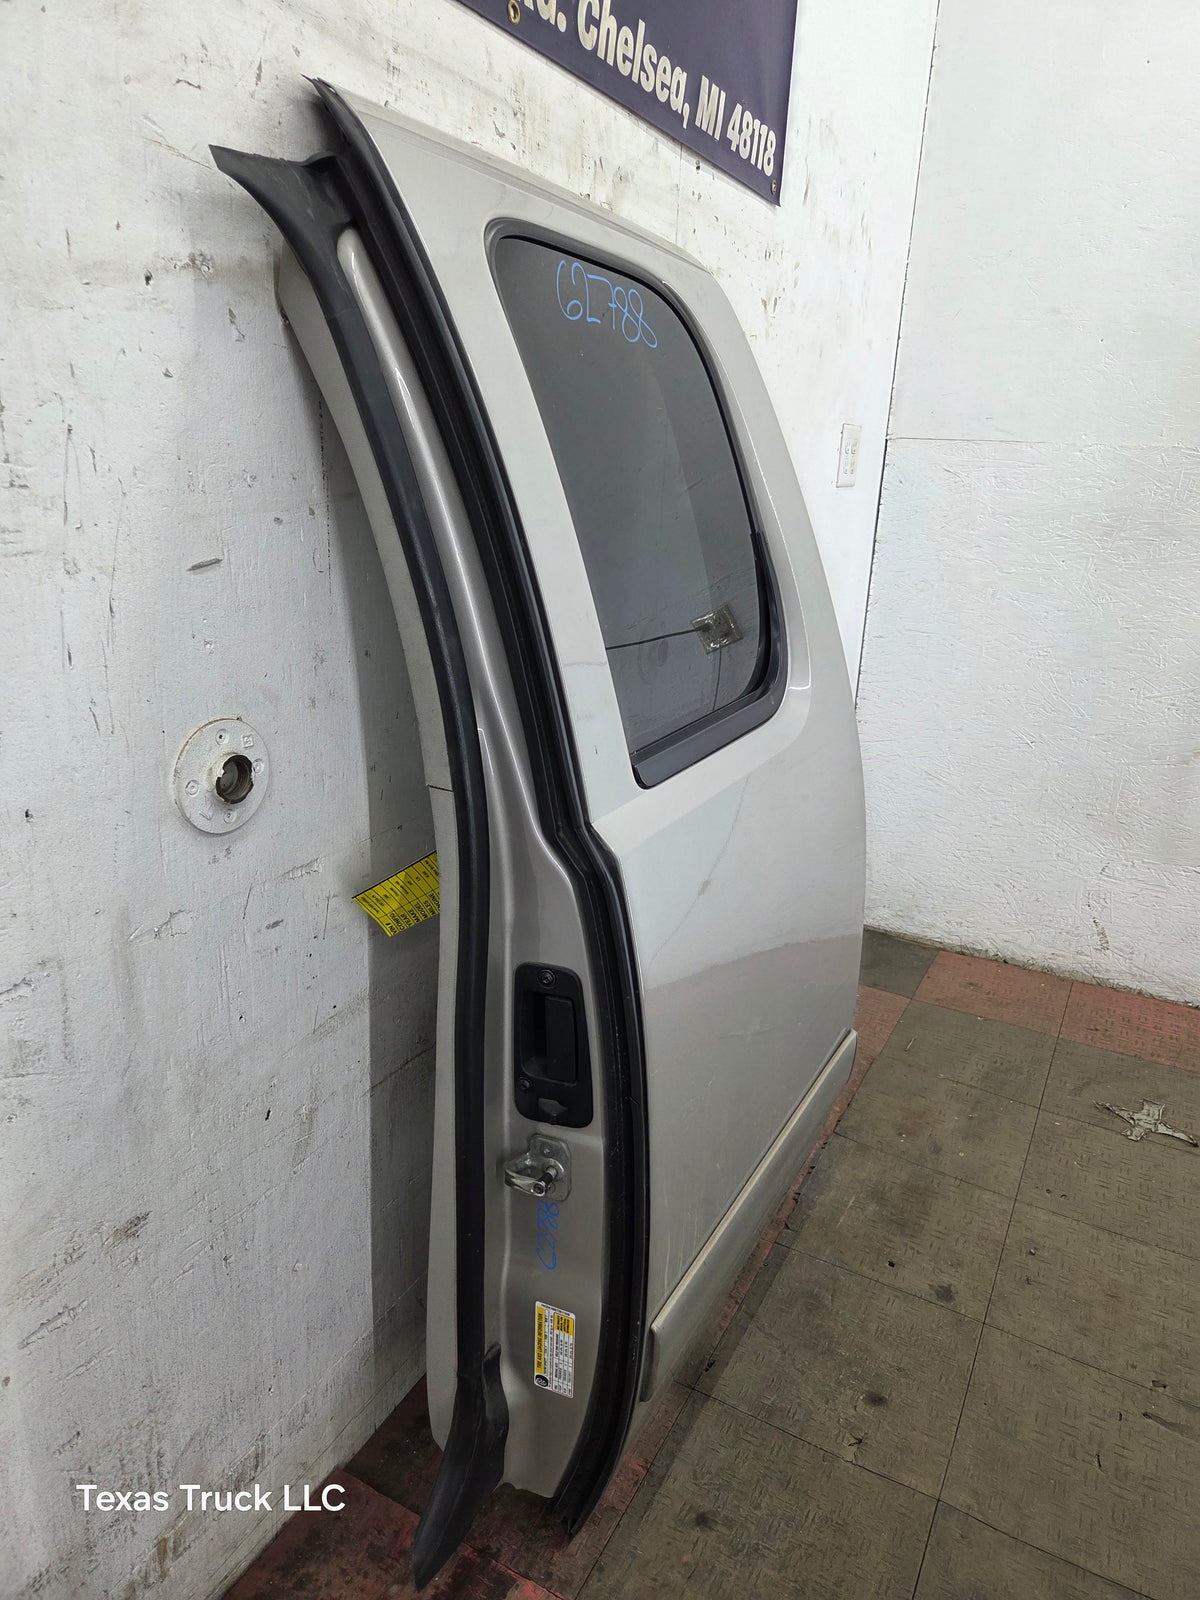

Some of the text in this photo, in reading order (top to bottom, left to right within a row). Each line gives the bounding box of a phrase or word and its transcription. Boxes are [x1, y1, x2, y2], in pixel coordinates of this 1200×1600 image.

[577, 0, 690, 129] Chelsea,
[695, 75, 726, 141] MI
[726, 103, 777, 177] 48118
[556, 260, 658, 348] 62788
[408, 909, 420, 923] MAKE
[414, 902, 428, 918] MODEL
[389, 913, 405, 931] CONFIG
[400, 913, 413, 927] YEAR
